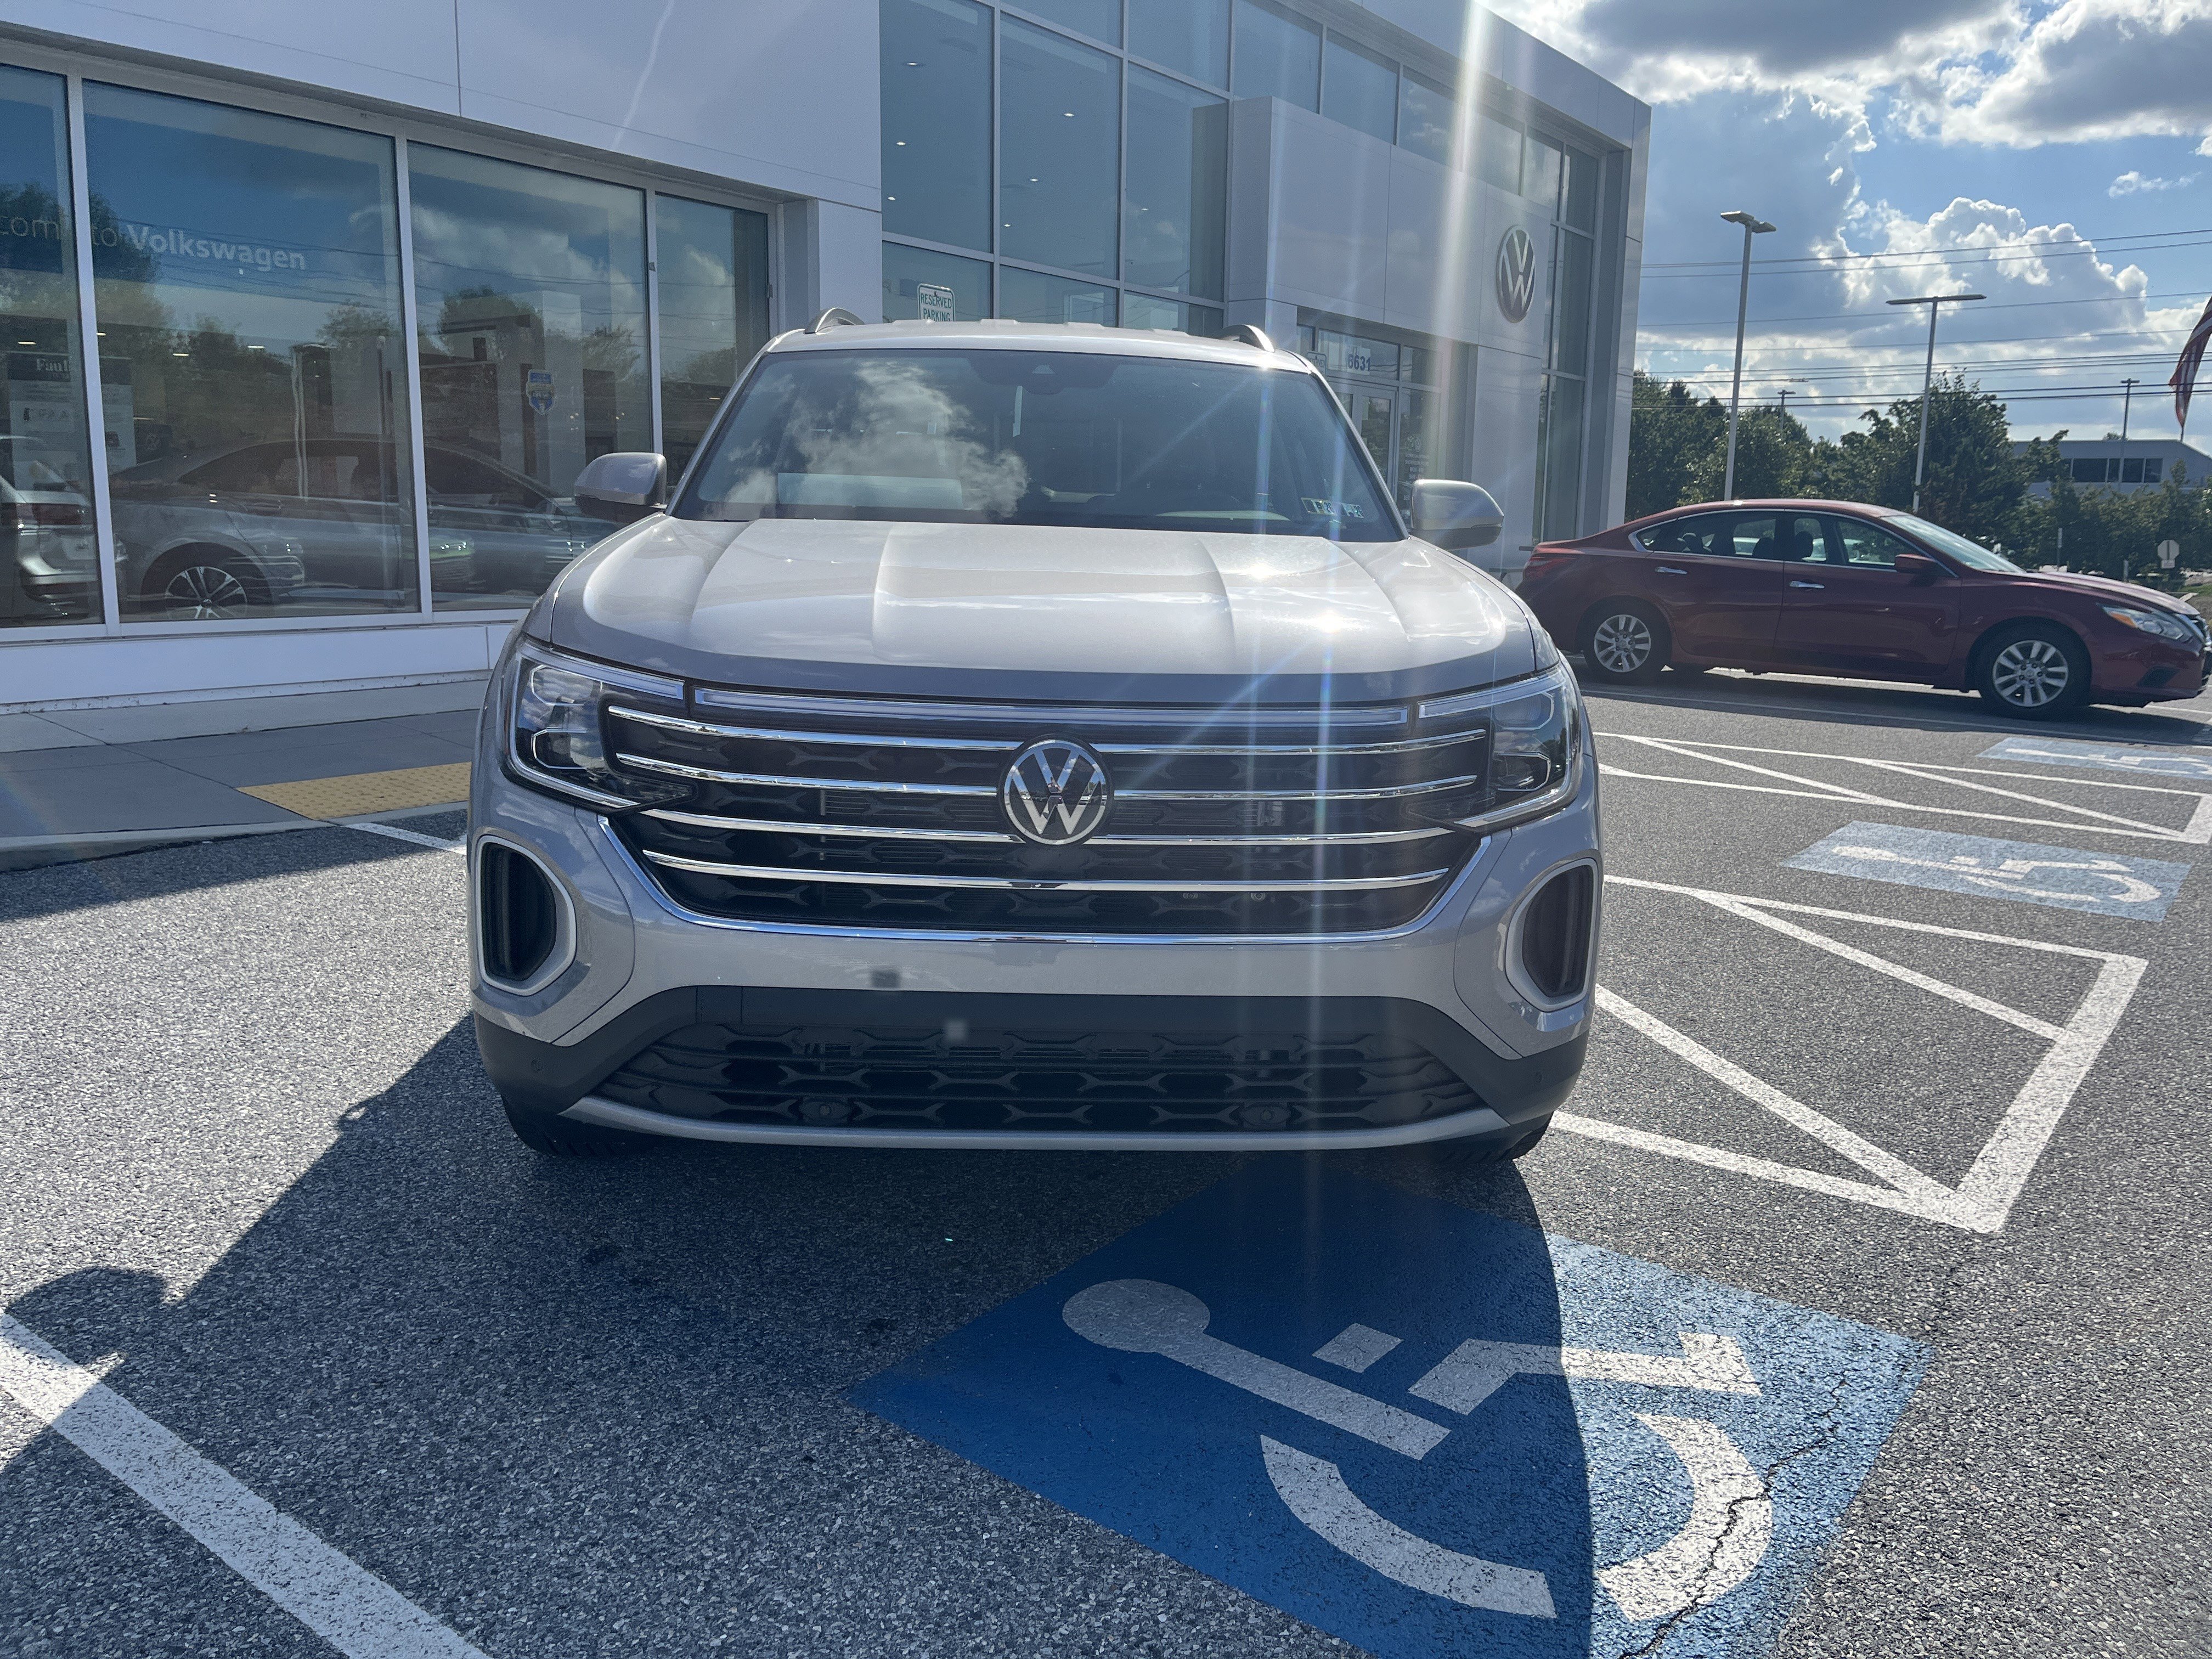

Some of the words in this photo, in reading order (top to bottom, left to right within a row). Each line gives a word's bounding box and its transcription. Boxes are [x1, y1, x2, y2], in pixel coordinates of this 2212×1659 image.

[91, 224, 117, 247] to
[127, 224, 306, 272] Volkswagen
[921, 293, 952, 308] RESERVED
[923, 309, 950, 321] PARKING
[36, 358, 69, 372] Faul
[1004, 740, 1107, 845] VW
